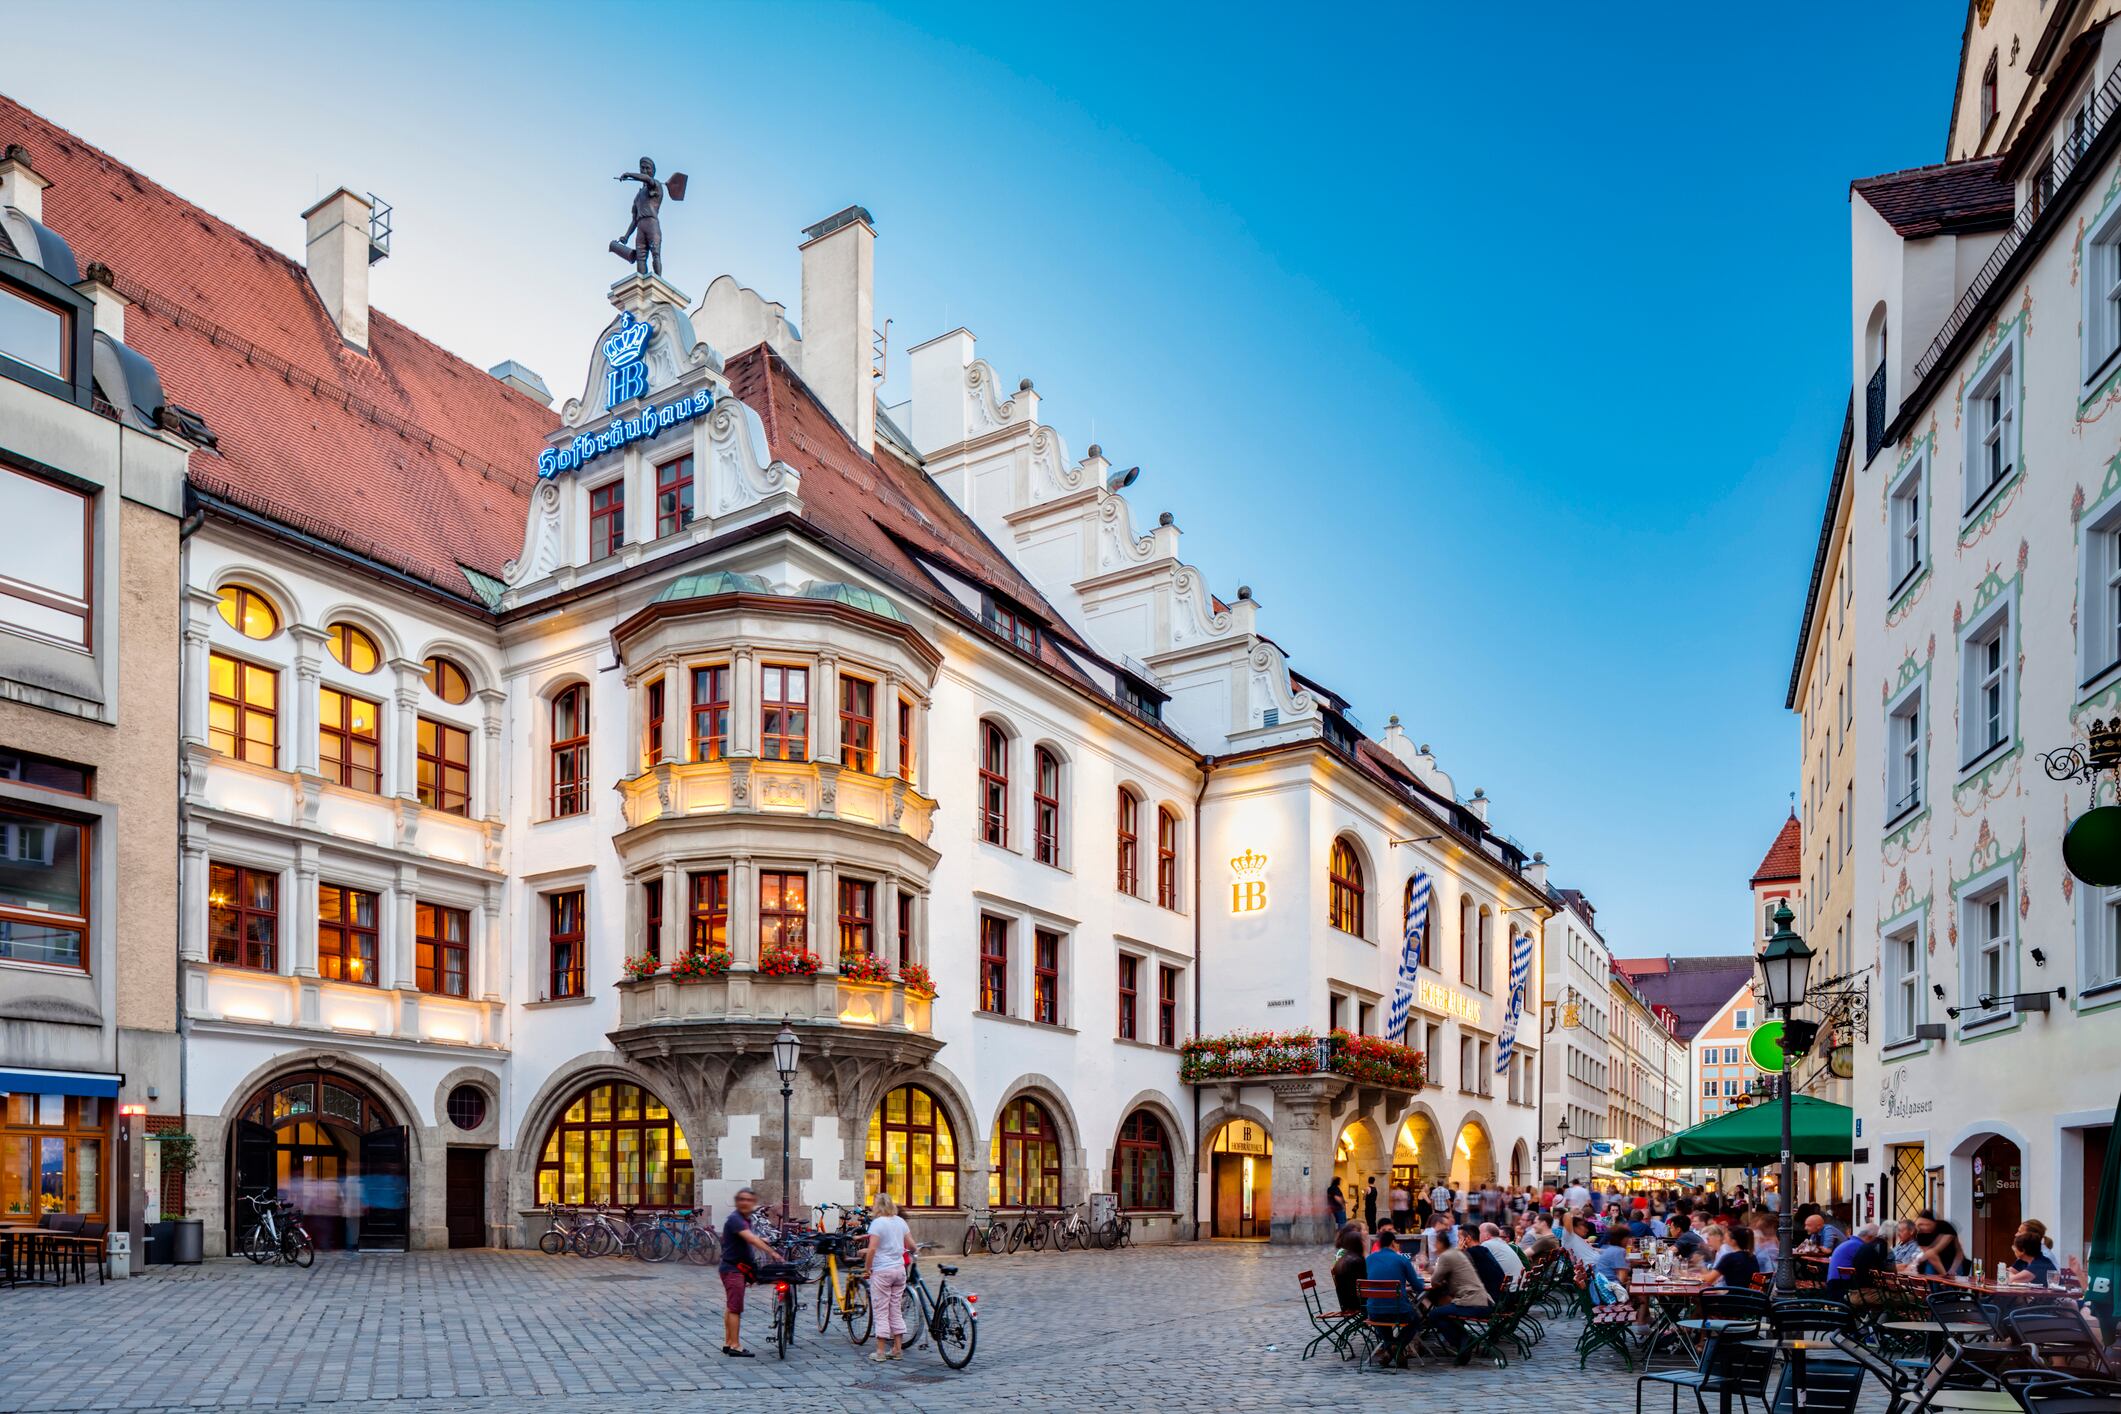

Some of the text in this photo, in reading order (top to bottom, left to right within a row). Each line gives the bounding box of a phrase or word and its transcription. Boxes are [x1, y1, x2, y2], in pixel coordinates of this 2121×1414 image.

[607, 360, 646, 409] HB
[538, 389, 714, 479] Hofbräuhaus
[1231, 880, 1267, 914] HB
[1243, 1126, 1252, 1141] HB
